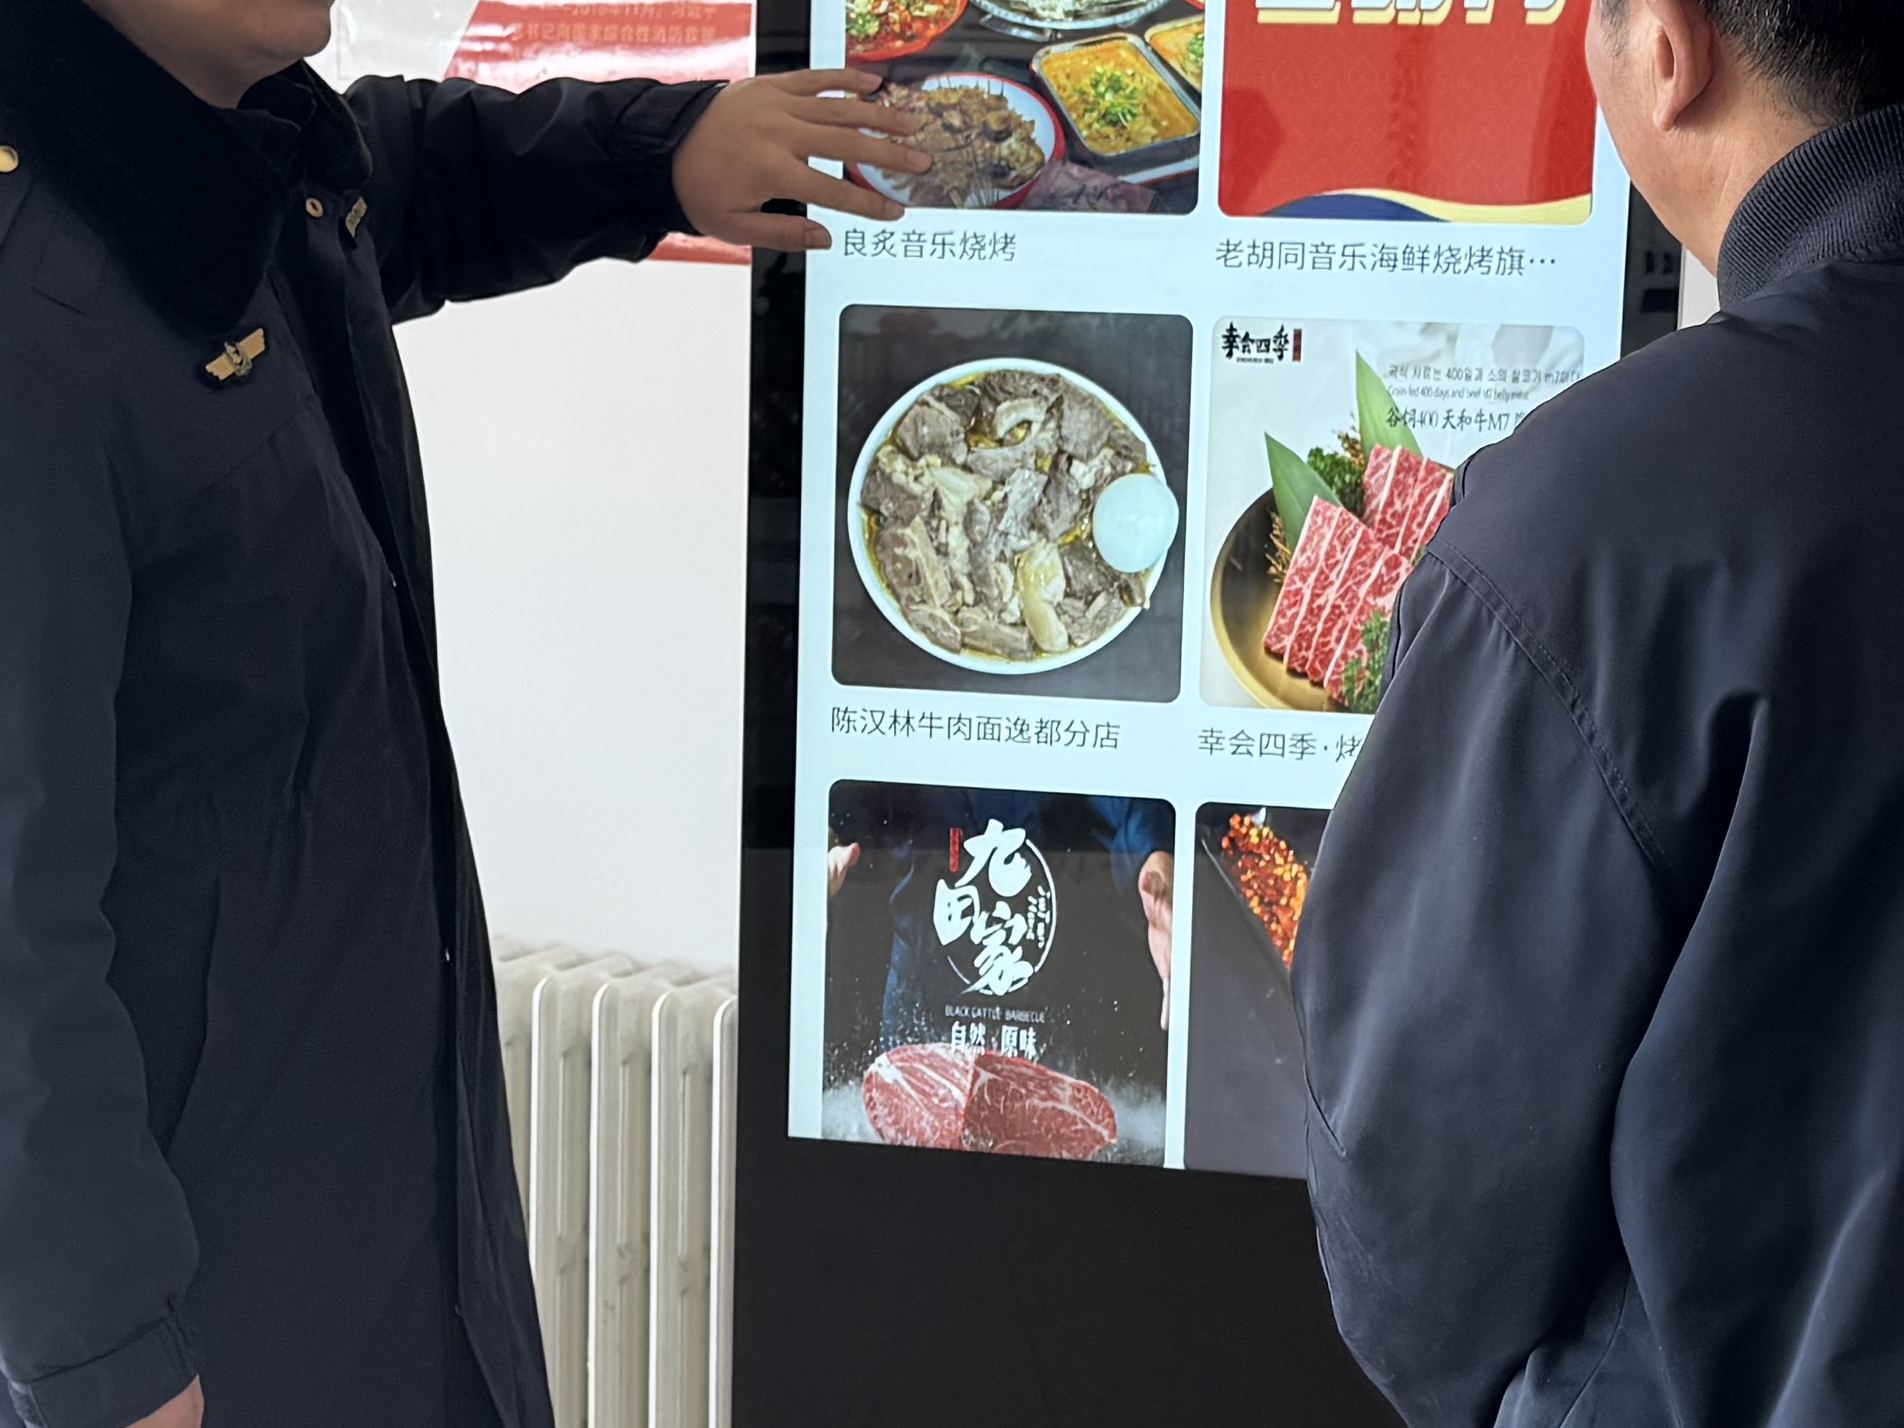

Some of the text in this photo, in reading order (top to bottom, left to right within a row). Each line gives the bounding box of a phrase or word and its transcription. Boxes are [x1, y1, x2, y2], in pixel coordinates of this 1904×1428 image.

[842, 228, 1018, 263] 良炙音乐烧烤
[830, 706, 1121, 750] 陈汉林牛肉面逸都分店
